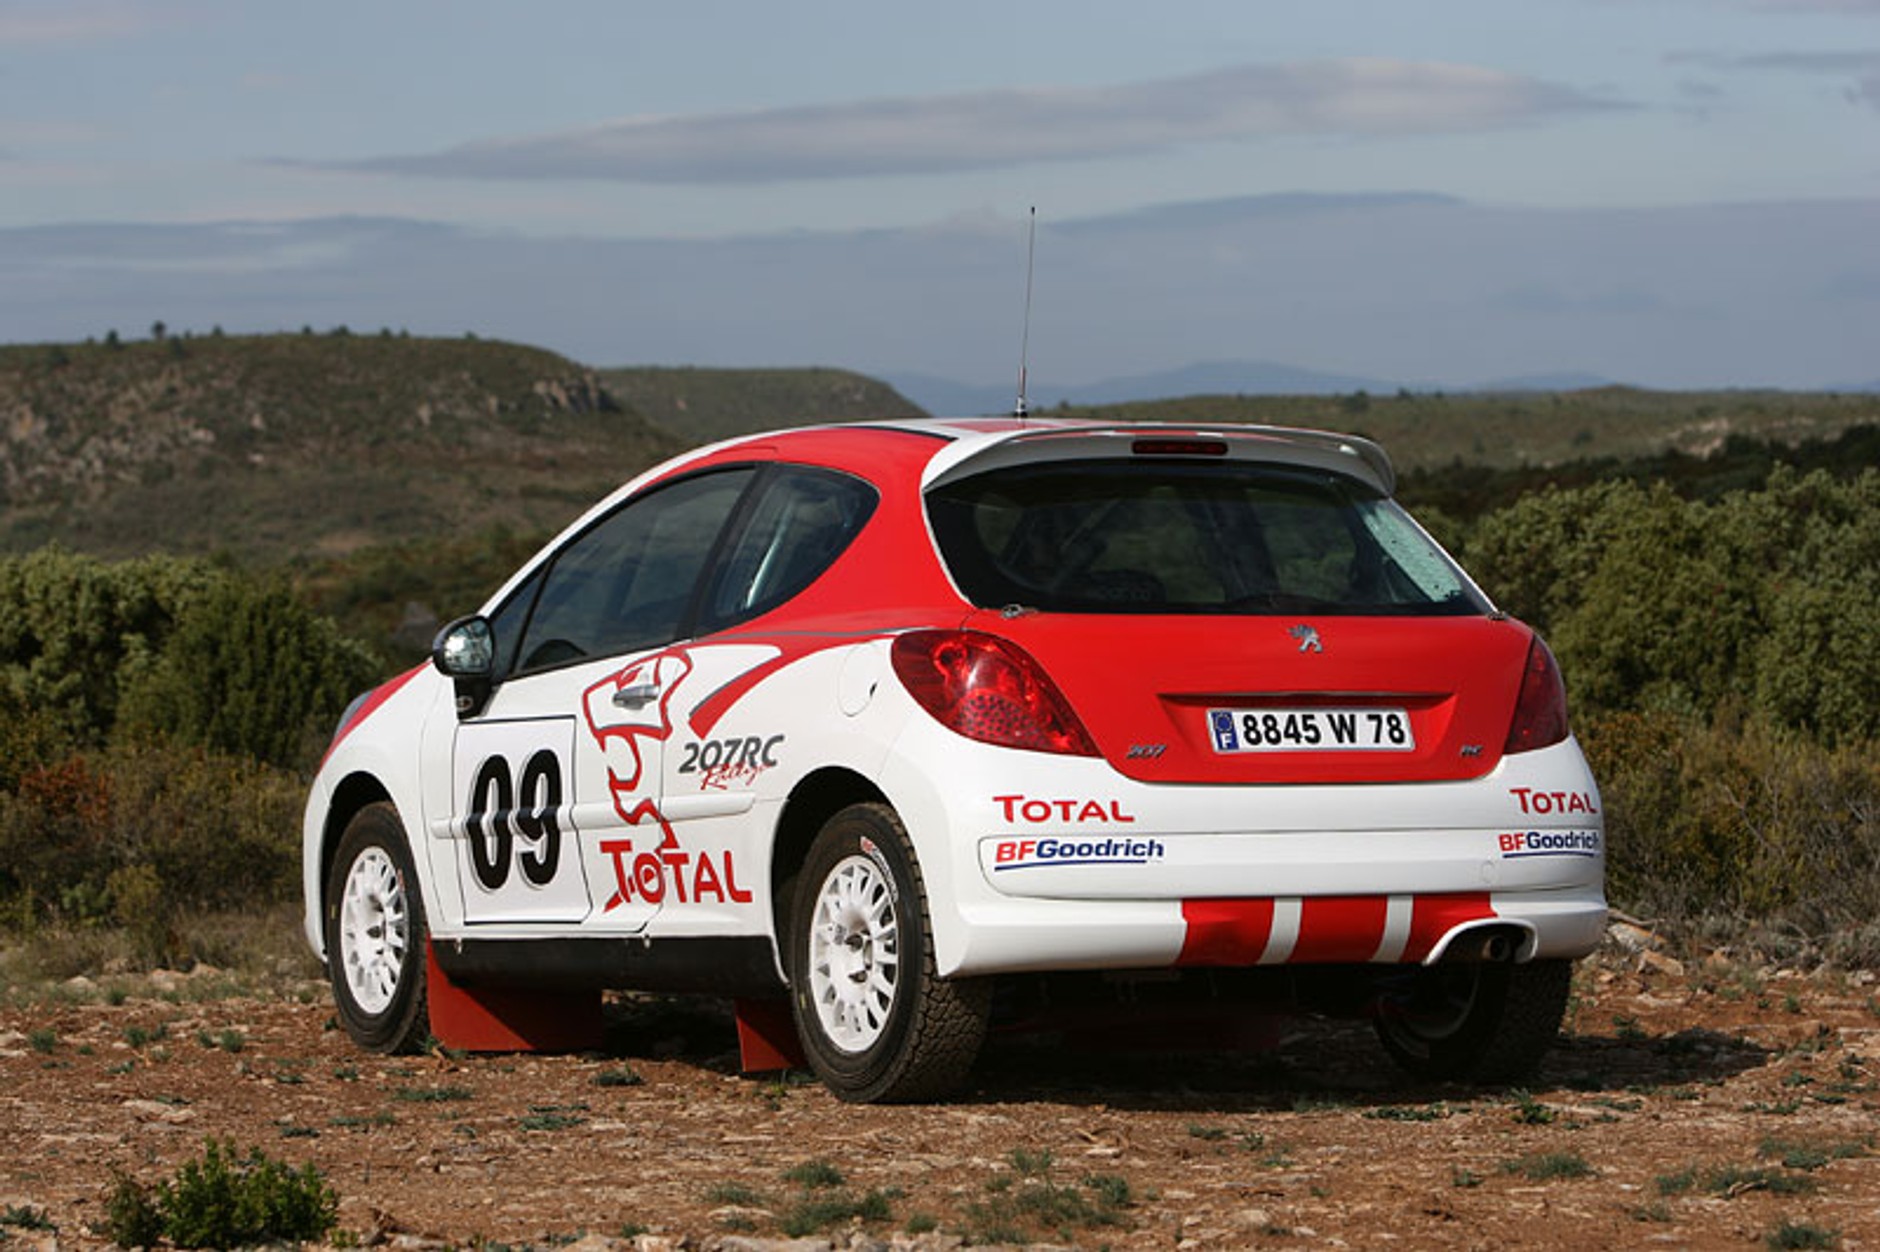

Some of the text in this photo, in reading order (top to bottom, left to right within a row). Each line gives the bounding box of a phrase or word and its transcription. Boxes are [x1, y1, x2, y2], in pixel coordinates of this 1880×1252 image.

[1220, 733, 1233, 749] F
[1242, 714, 1405, 746] 8845 W 78
[678, 735, 786, 774] 207RC
[1126, 745, 1166, 759] 207
[993, 794, 1135, 823] TOTAL
[1509, 787, 1598, 814] TOTAL
[466, 749, 561, 889] 09
[995, 839, 1164, 862] BFGoodrich
[599, 839, 752, 905] TOTAL
